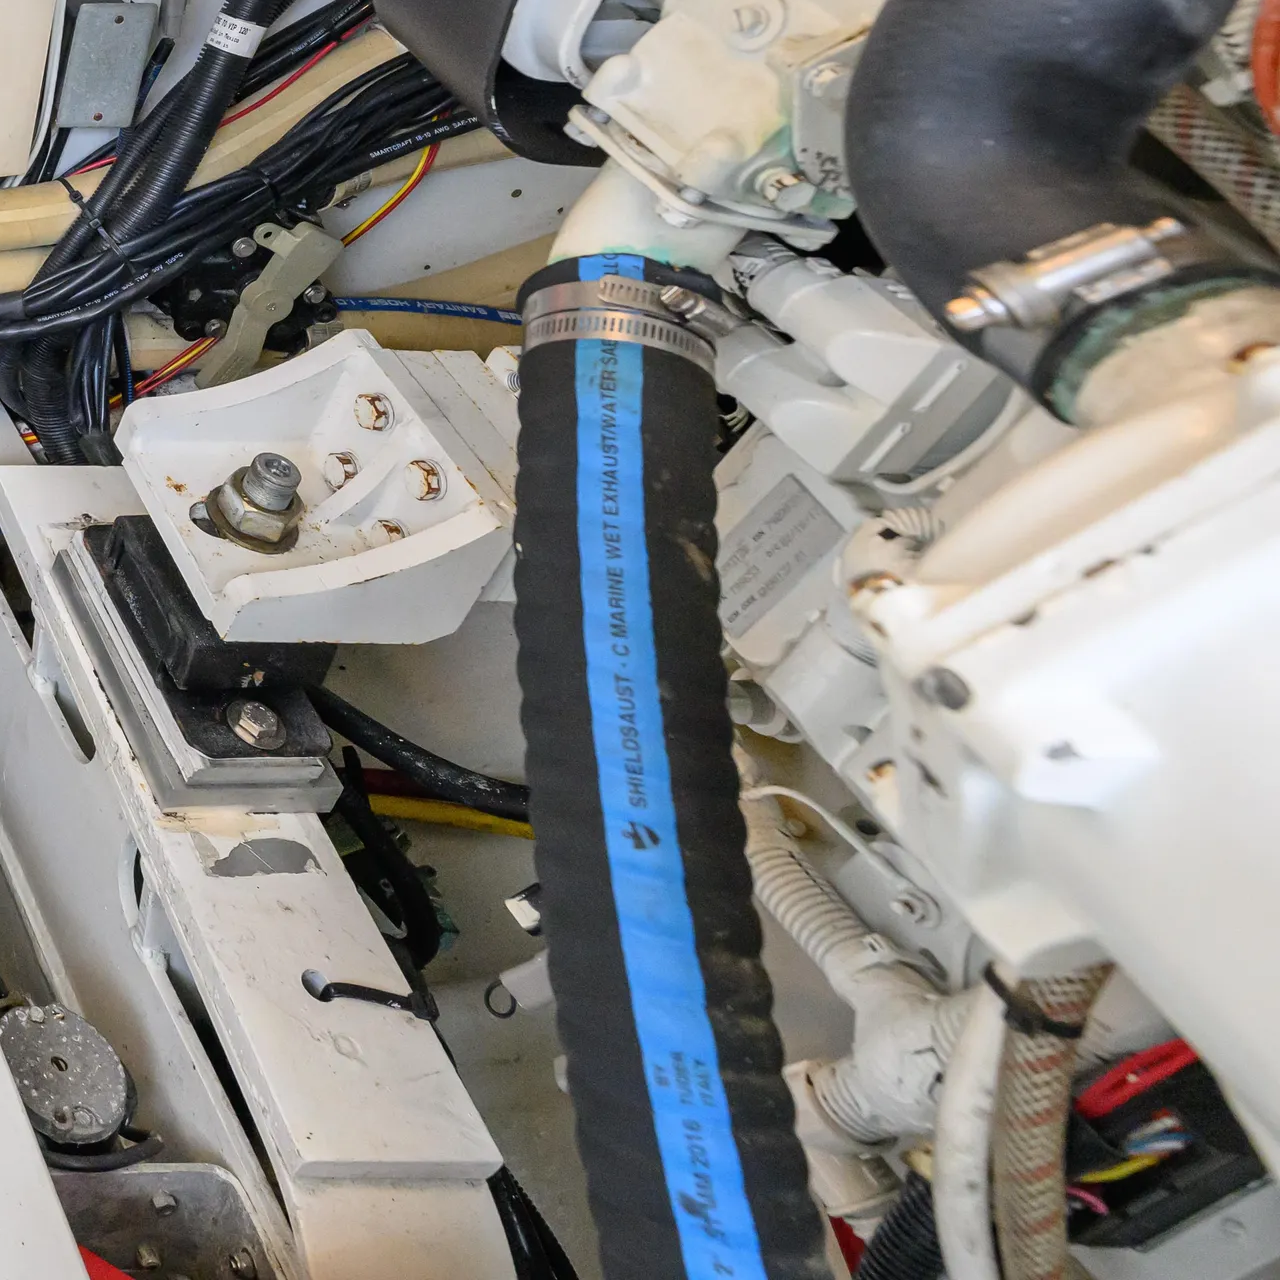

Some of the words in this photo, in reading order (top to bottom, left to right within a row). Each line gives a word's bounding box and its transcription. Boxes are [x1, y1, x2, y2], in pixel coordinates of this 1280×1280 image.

[370, 138, 413, 158] SMARTCRAFT
[415, 132, 431, 142] 18-10
[434, 126, 450, 135] AWG
[37, 306, 81, 322] SMARTCRAFT
[103, 290, 119, 300] AWG
[416, 301, 488, 315] SANITARY
[598, 371, 621, 518] EXHAUST/WATER
[602, 520, 624, 569] WET
[606, 564, 629, 641] MARINE
